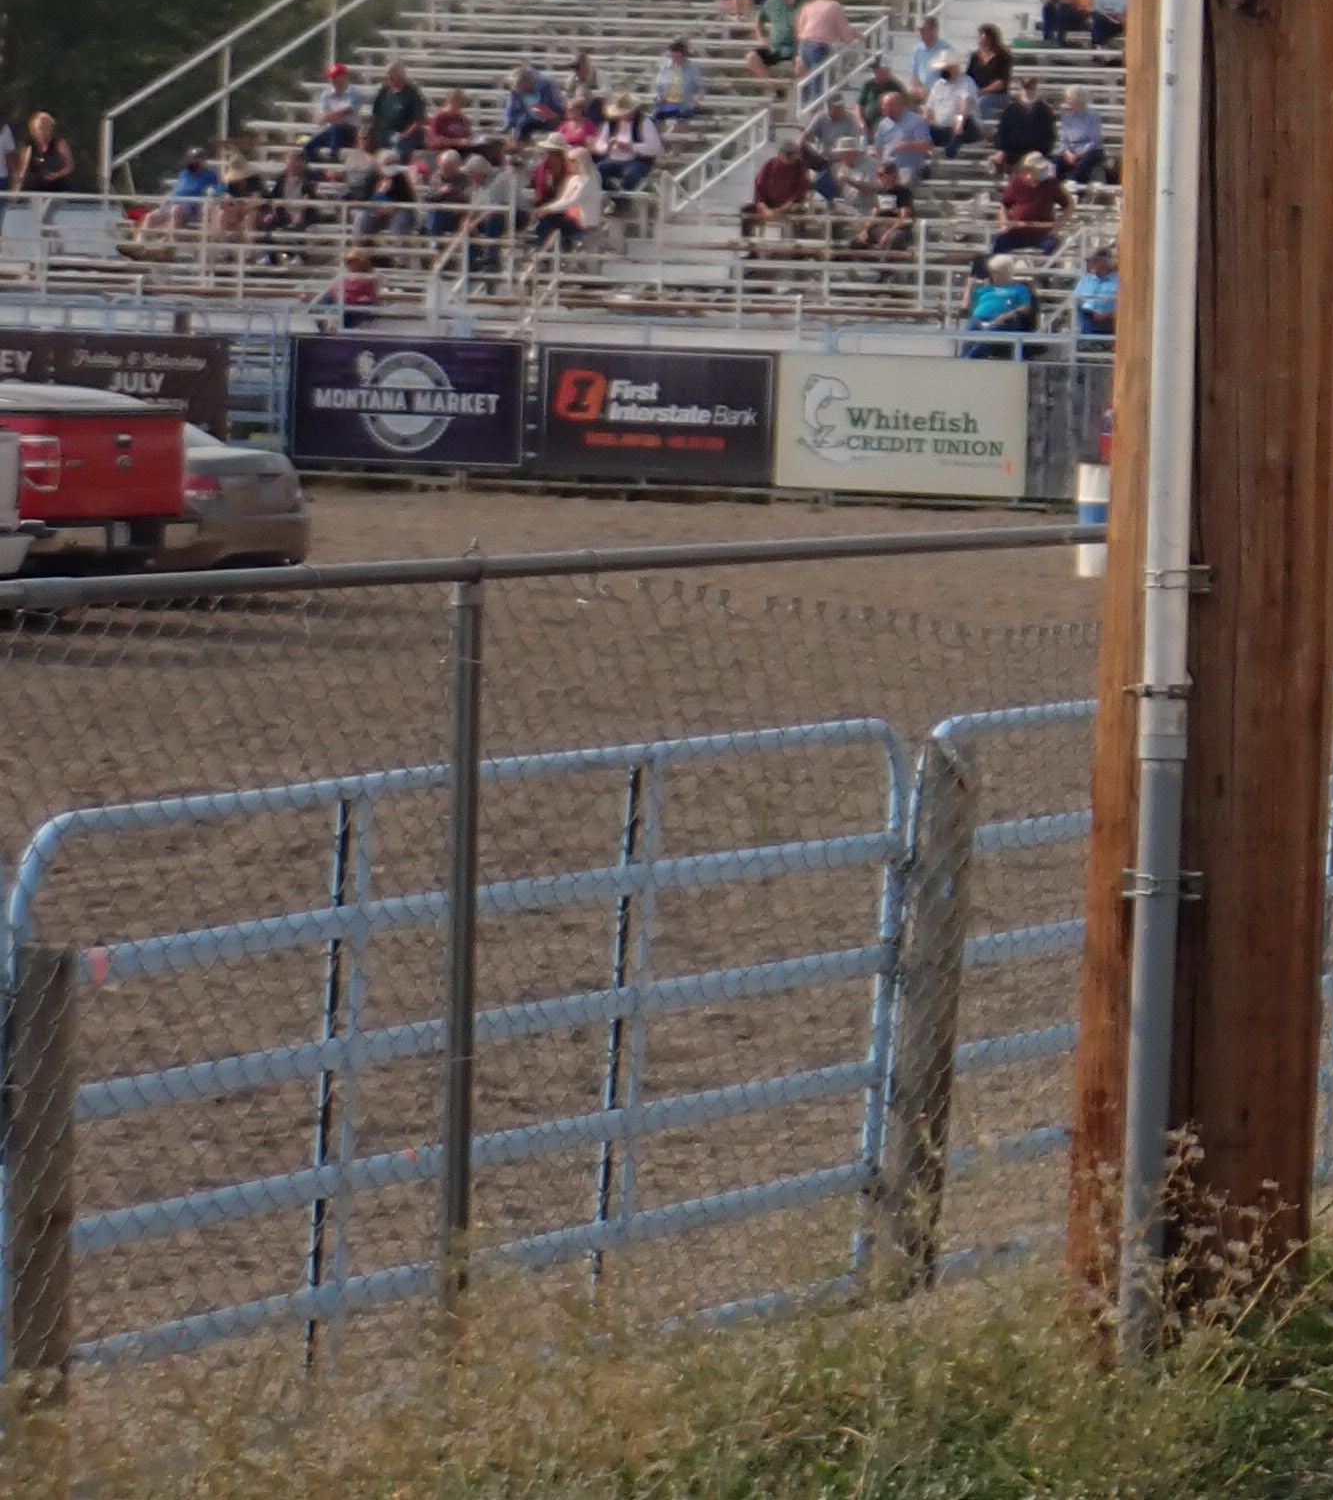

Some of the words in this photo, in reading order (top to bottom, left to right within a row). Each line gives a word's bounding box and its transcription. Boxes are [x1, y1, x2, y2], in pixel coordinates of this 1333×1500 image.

[109, 371, 165, 393] JULY
[609, 379, 661, 400] First
[314, 388, 407, 411] MONTANA
[414, 392, 499, 415] MARKET
[608, 402, 711, 424] Interstate
[712, 405, 757, 427] Bank
[846, 407, 979, 434] Whitefish
[847, 434, 926, 453] CREDIT
[932, 438, 1004, 457] UNION
